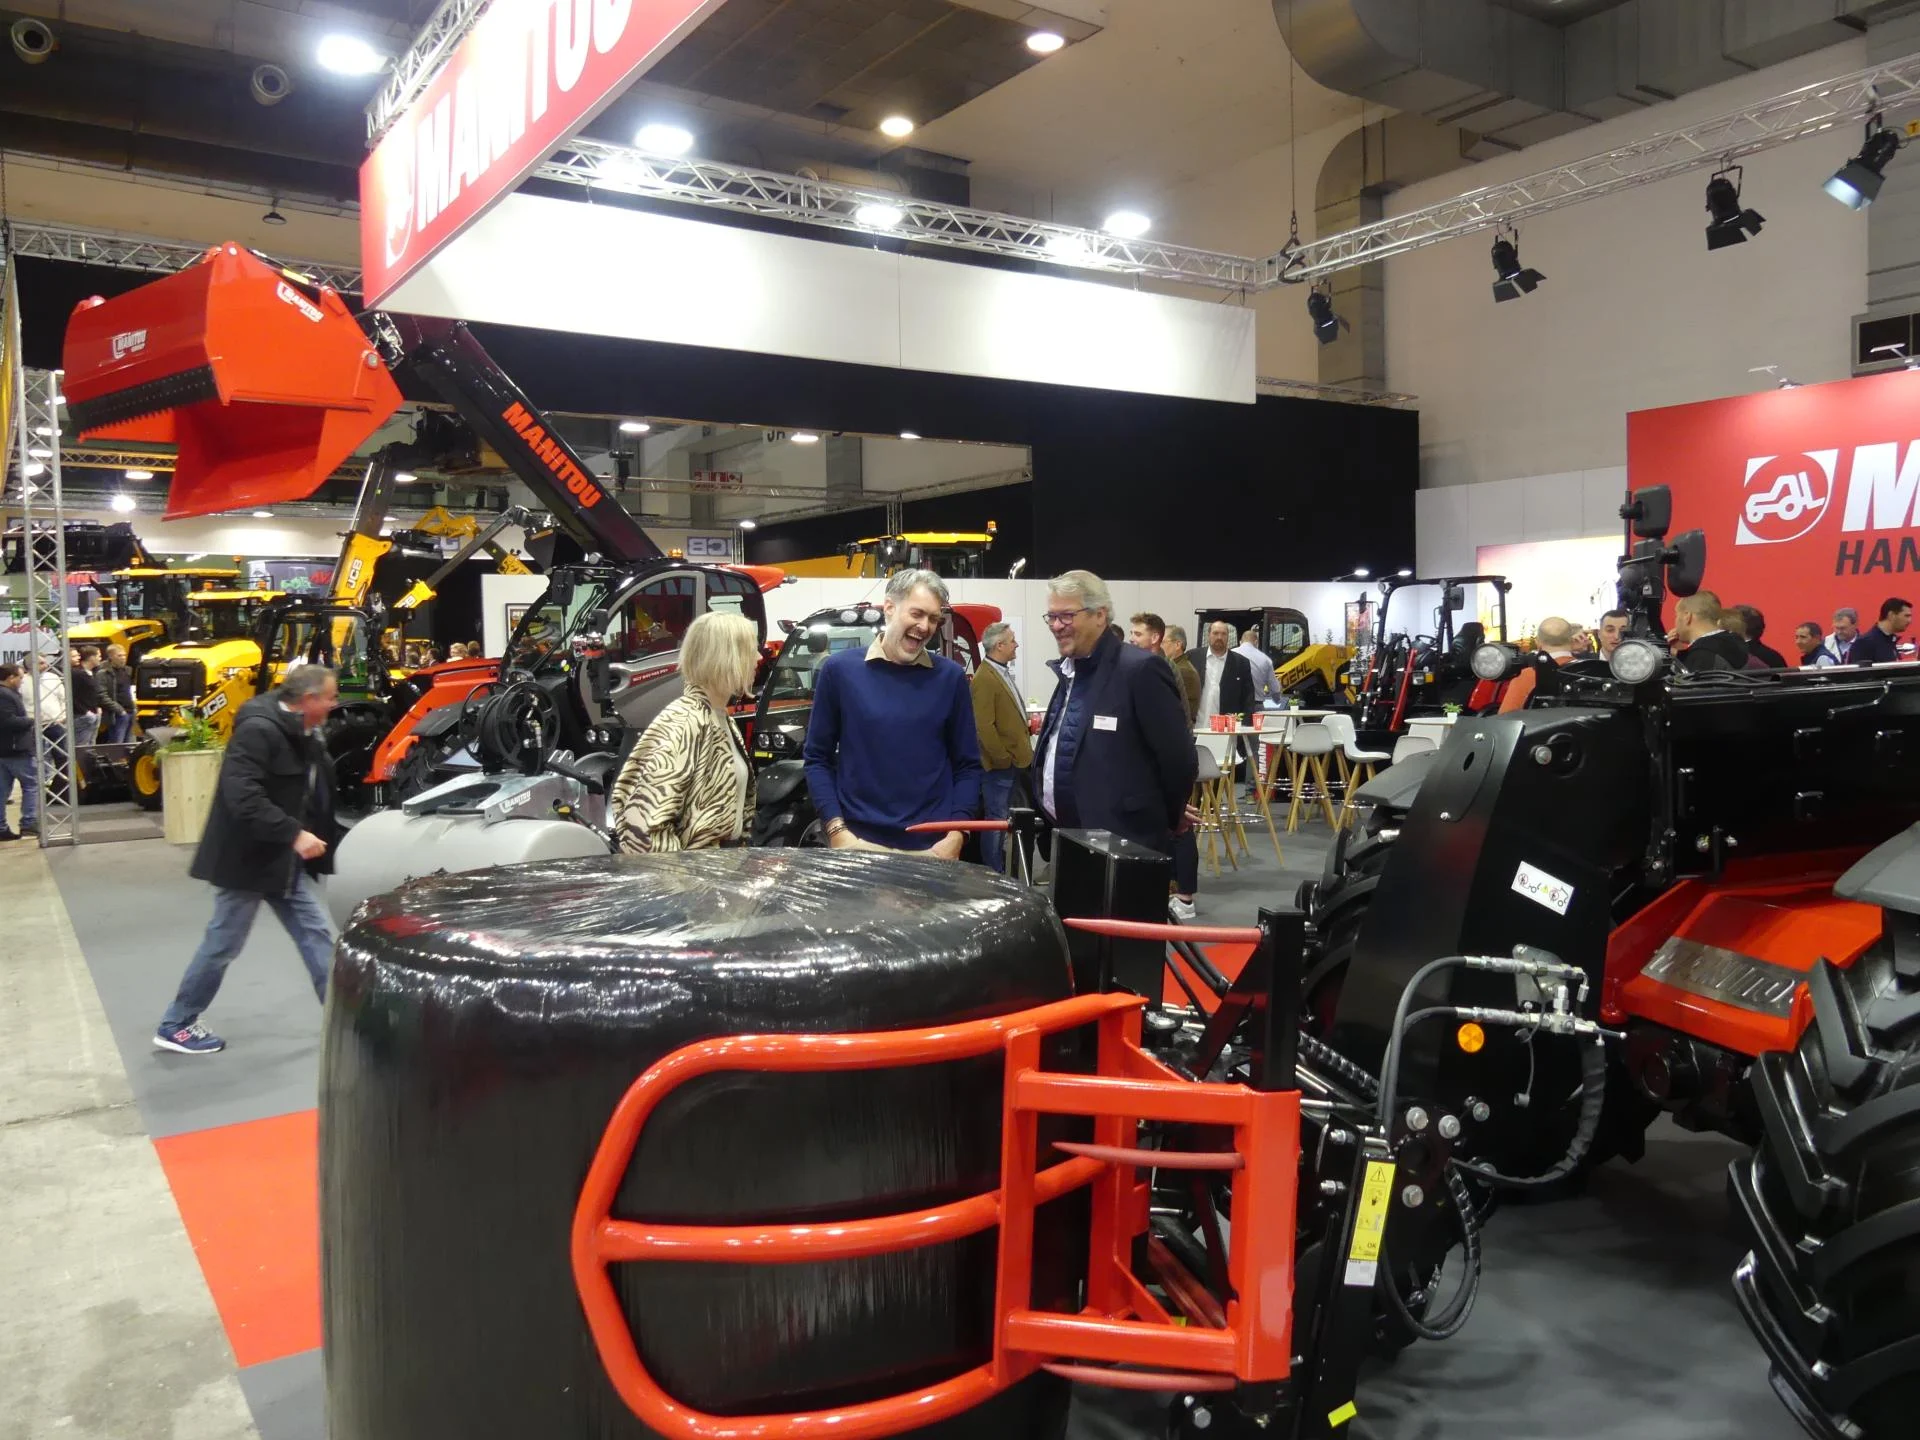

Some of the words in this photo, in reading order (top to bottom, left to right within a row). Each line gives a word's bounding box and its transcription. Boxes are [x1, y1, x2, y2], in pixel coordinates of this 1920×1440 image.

[502, 401, 602, 508] MANITOU
[347, 559, 363, 588] JCB
[150, 677, 178, 688] JCB
[1283, 663, 1312, 687] GEHL
